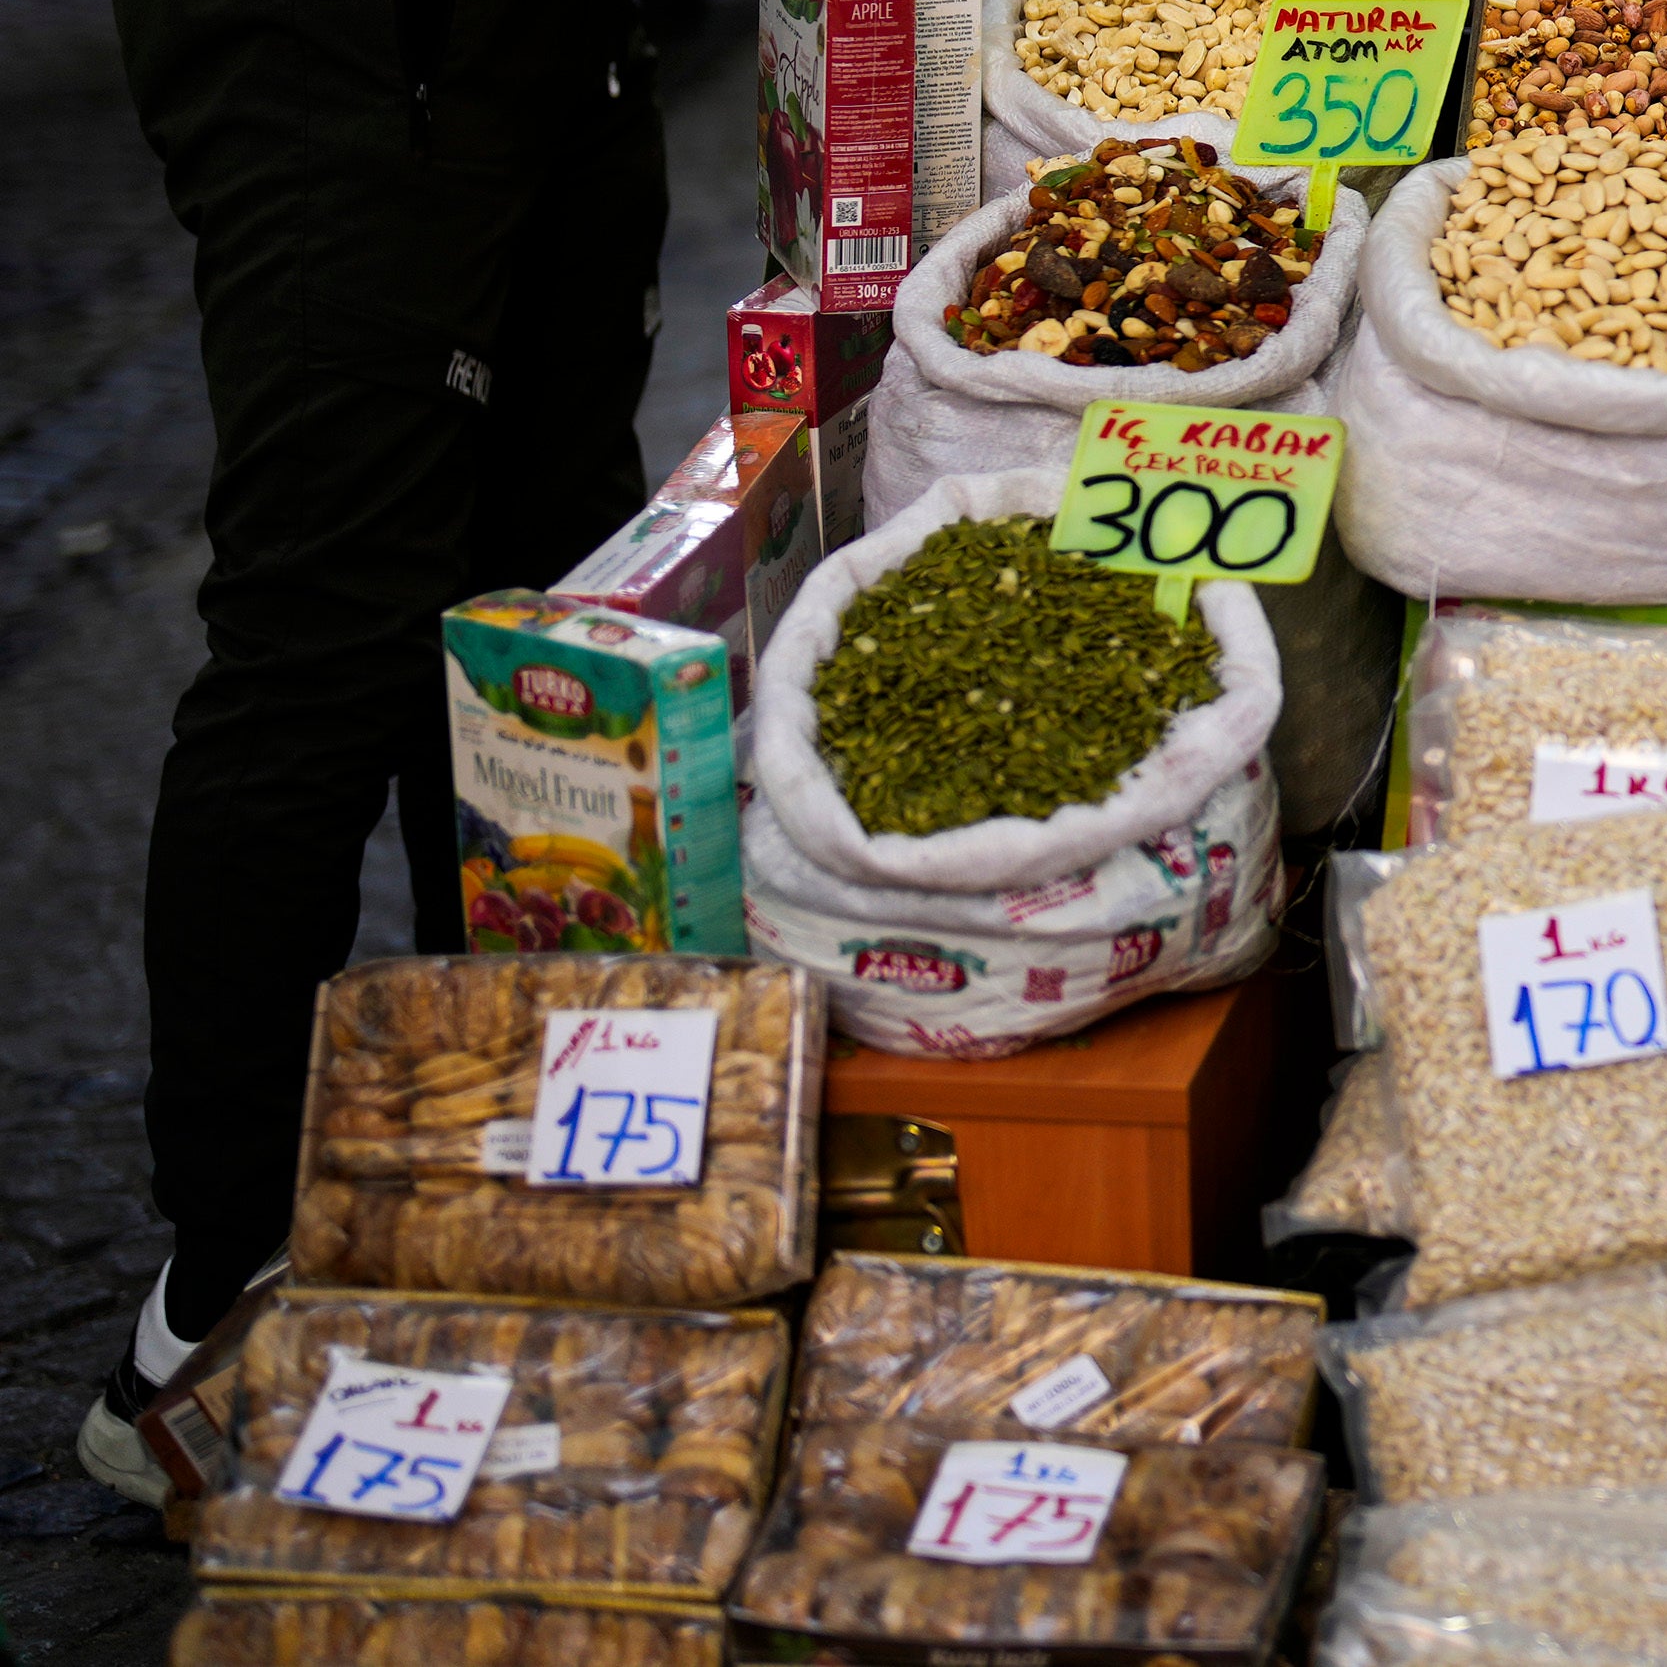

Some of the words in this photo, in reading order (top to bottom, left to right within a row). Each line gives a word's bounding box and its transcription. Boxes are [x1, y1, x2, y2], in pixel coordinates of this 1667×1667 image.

[851, 1, 894, 21] APPLE
[1273, 6, 1438, 35] NATURAL
[1281, 36, 1379, 64] ATOM
[1258, 69, 1418, 157] 350
[839, 228, 859, 238] ÜRÜN
[860, 227, 879, 237] KODU
[882, 226, 900, 236] T-253
[840, 265, 865, 273] 681414
[872, 262, 898, 271] 009753
[856, 283, 879, 299] 300
[828, 442, 845, 466] Nar
[1179, 422, 1332, 459] KABAK
[1123, 450, 1297, 488] ÇEKİRDEK
[1055, 472, 1296, 571] 300
[473, 751, 549, 808] Mixed
[553, 771, 617, 822] Fruit
[1582, 760, 1621, 797] 1
[1536, 916, 1586, 964] 1
[1512, 968, 1662, 1076] 170
[542, 1083, 700, 1182] 175
[278, 1431, 462, 1511] 175
[915, 1482, 1107, 1552] 175
